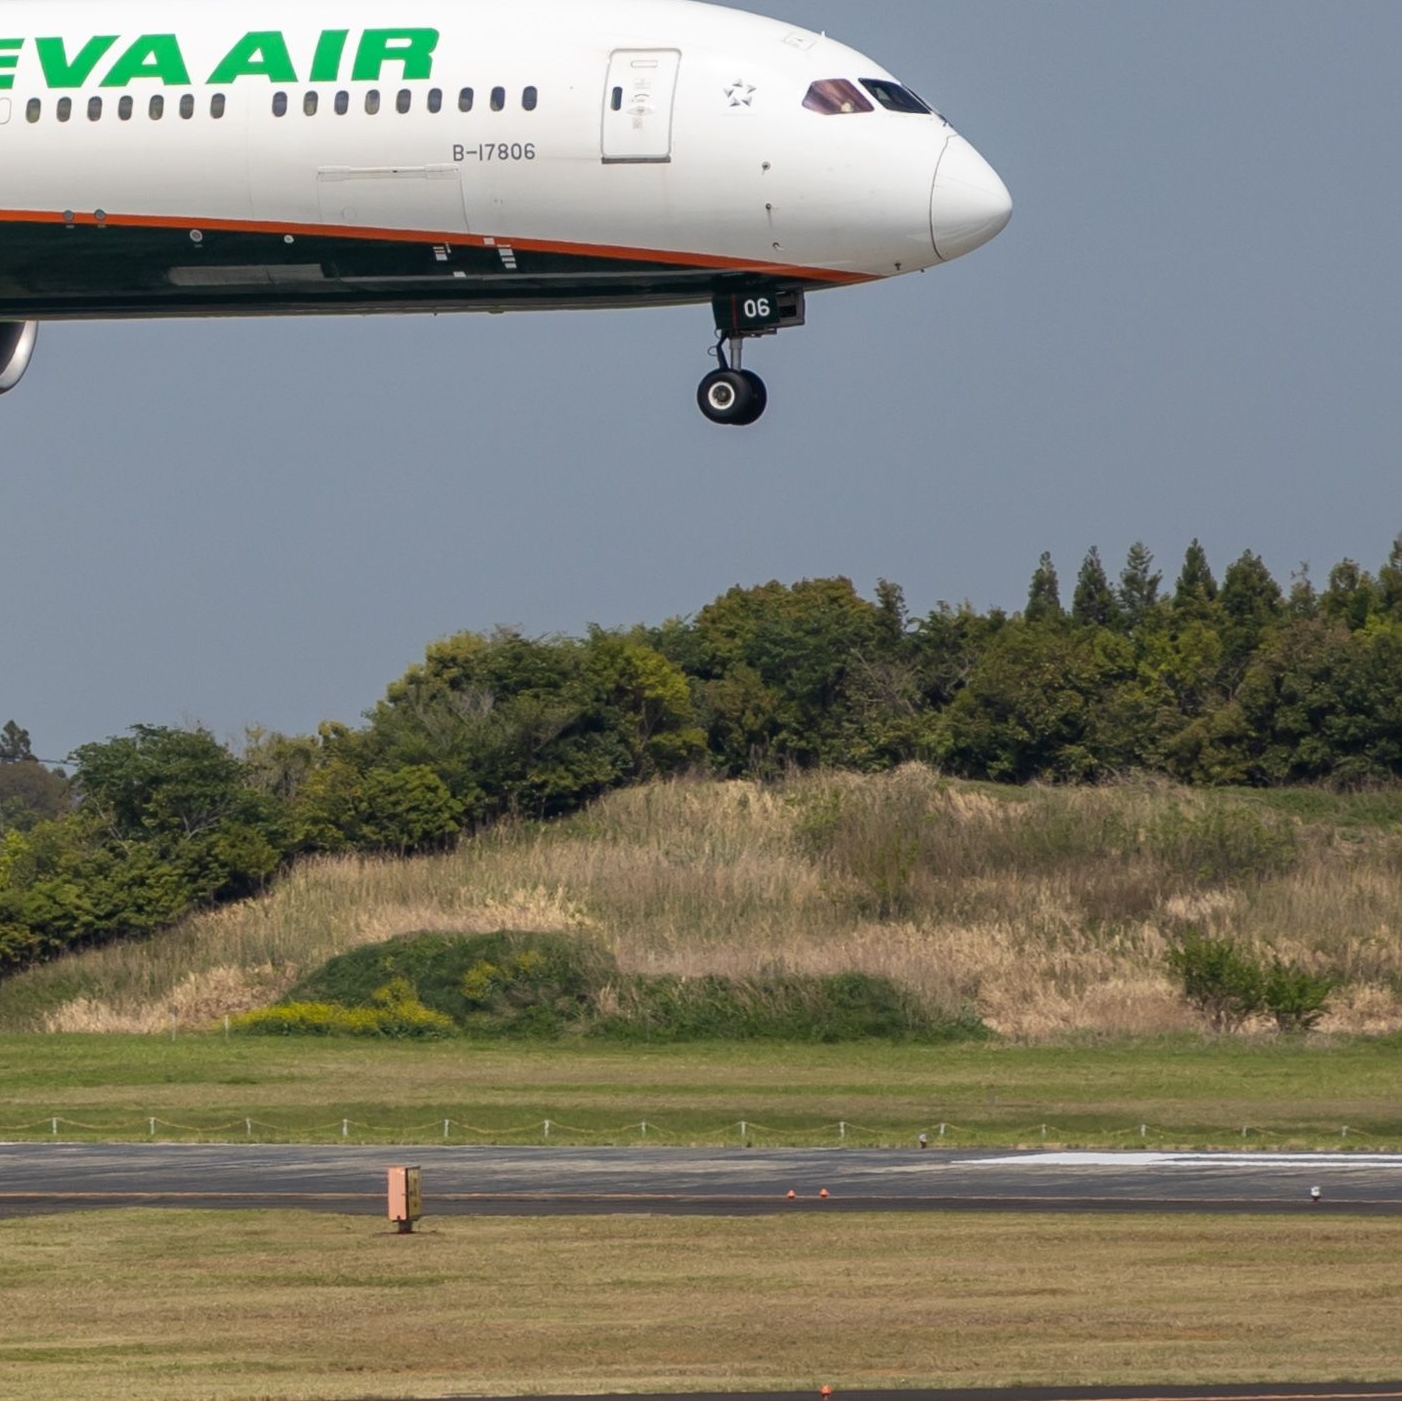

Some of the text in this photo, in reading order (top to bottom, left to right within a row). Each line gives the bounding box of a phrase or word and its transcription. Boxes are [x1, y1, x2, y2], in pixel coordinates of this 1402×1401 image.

[205, 27, 441, 85] AIR
[452, 143, 536, 161] B-17806
[743, 297, 771, 318] 06
